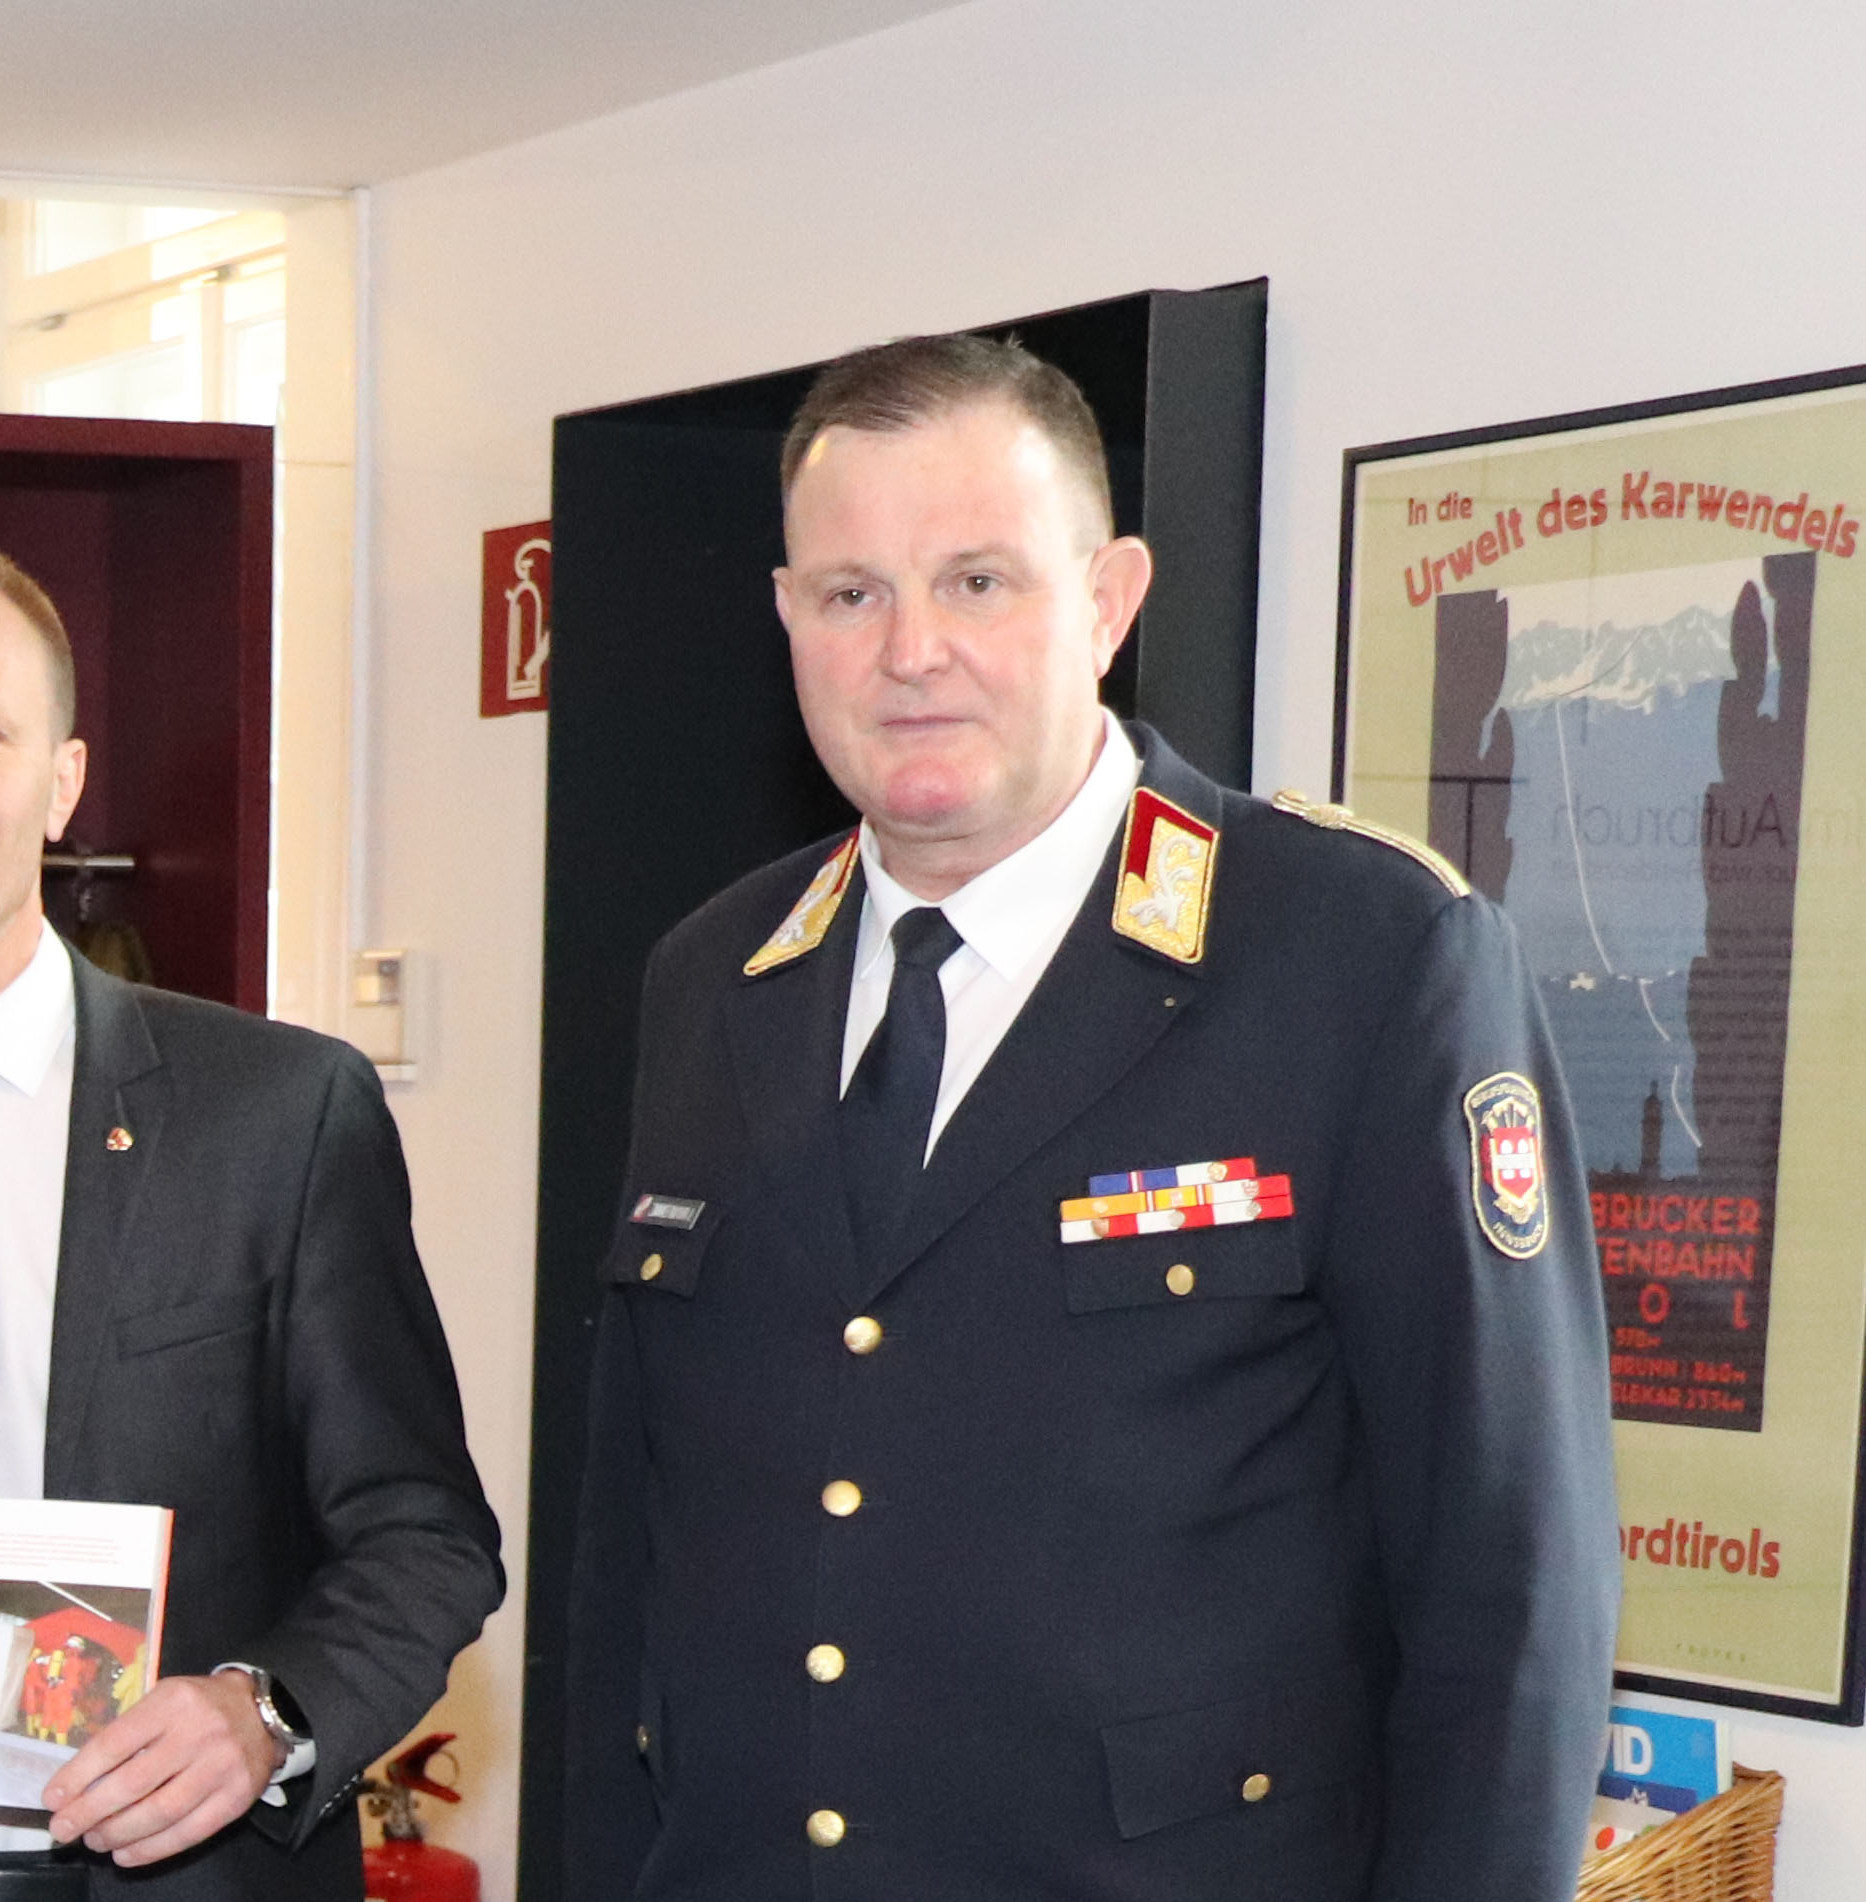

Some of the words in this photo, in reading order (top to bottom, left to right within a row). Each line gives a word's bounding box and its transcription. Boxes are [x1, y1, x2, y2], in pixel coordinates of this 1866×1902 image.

[1407, 498, 1428, 526] In
[1436, 491, 1473, 522] die
[1404, 506, 1526, 606] Urwelt
[1536, 488, 1608, 538] des
[1620, 470, 1862, 559] Karwendels
[1590, 1190, 1761, 1236] BRUCKER
[1595, 1236, 1756, 1281] ENBAHN
[1619, 1517, 1780, 1578] rdtirols
